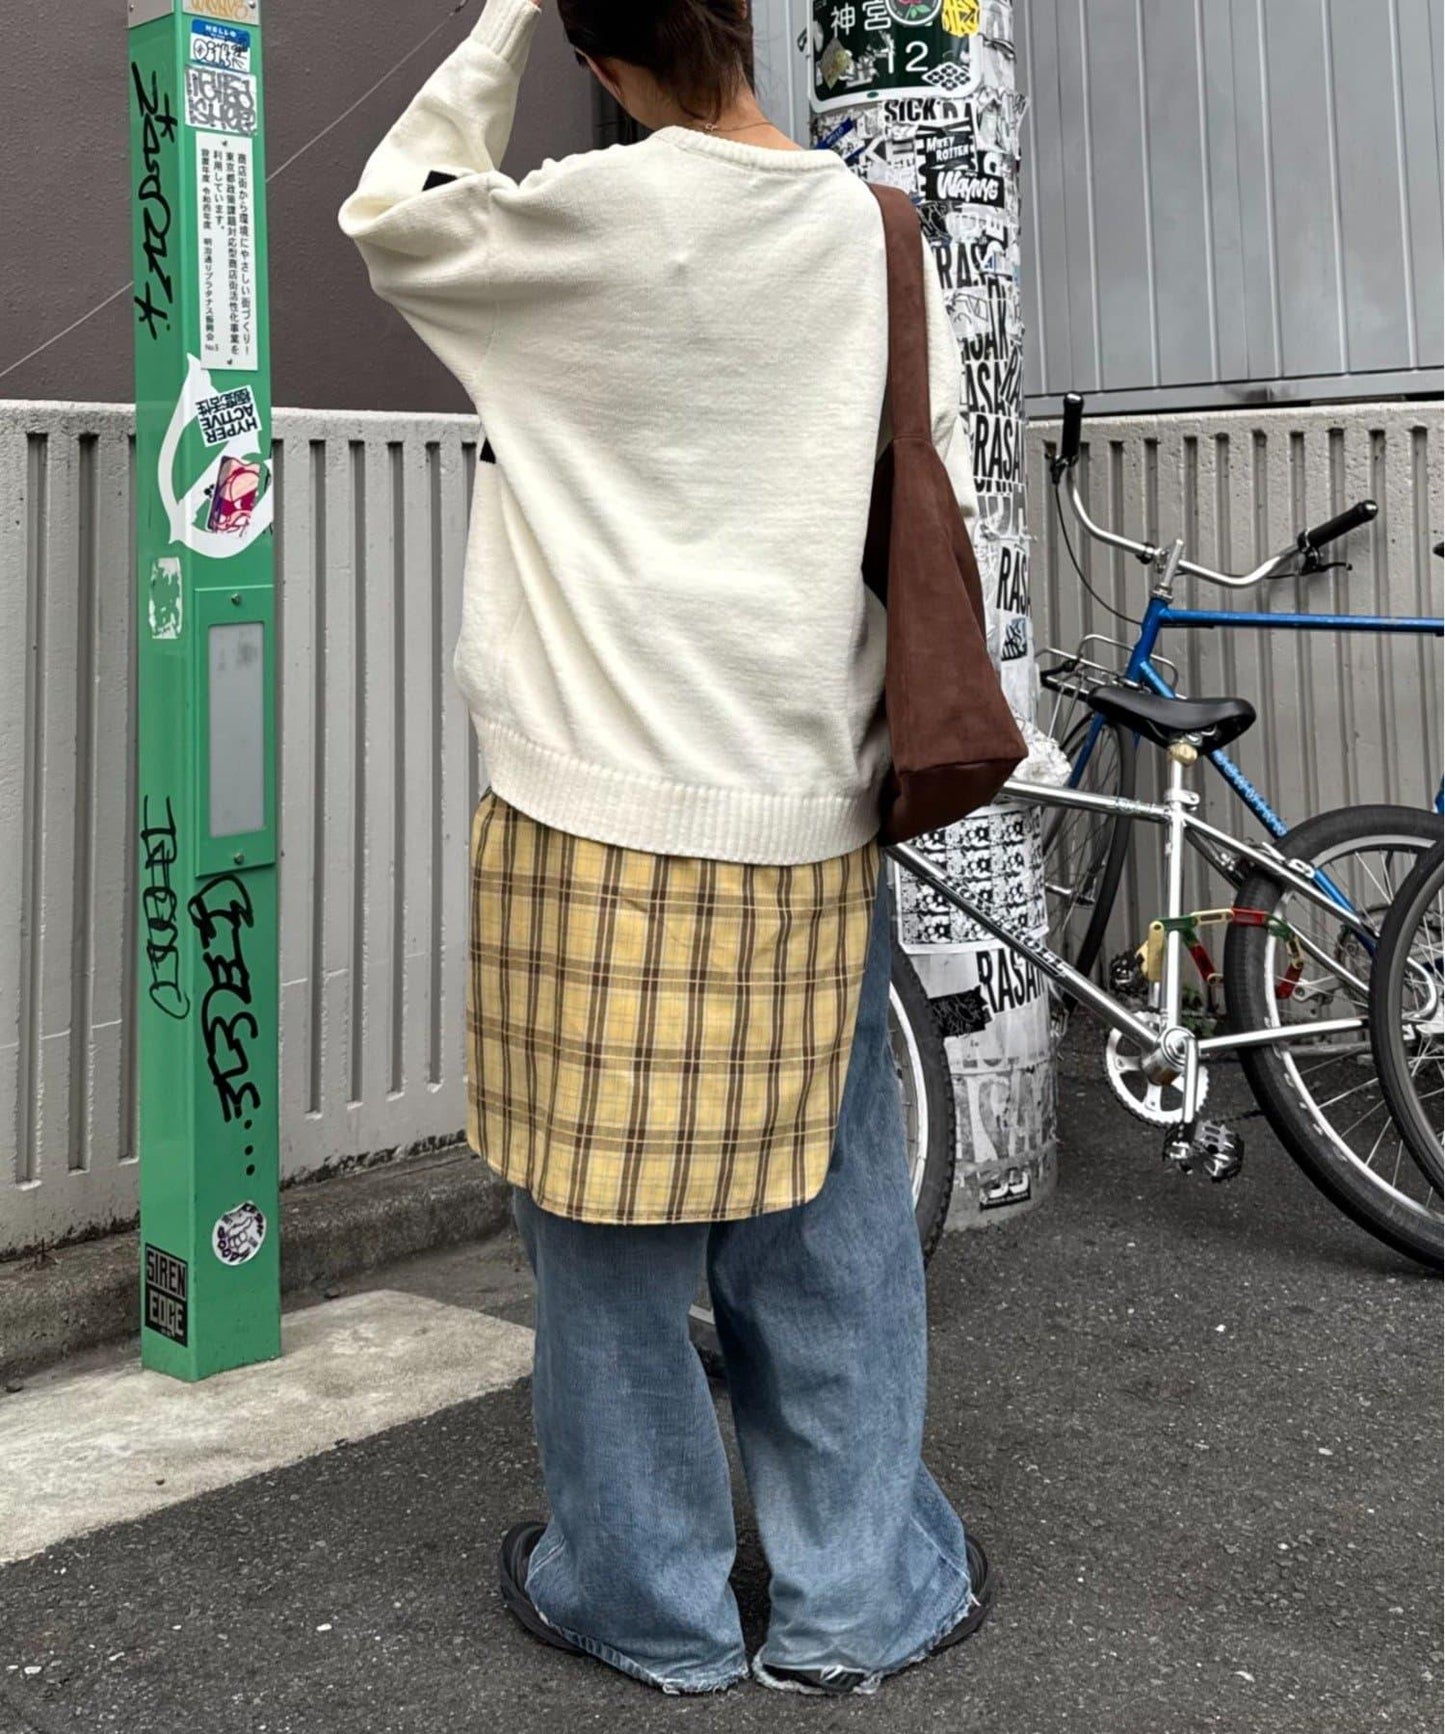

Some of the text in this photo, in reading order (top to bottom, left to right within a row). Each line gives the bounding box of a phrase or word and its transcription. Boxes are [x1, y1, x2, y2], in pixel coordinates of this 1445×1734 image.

[830, 0, 892, 37] 神宮
[884, 98, 937, 121] SICK
[200, 403, 253, 431] ACTIVE
[205, 417, 258, 444] HYPER
[146, 1248, 186, 1298] SIREN
[149, 1288, 184, 1337] EDGE
